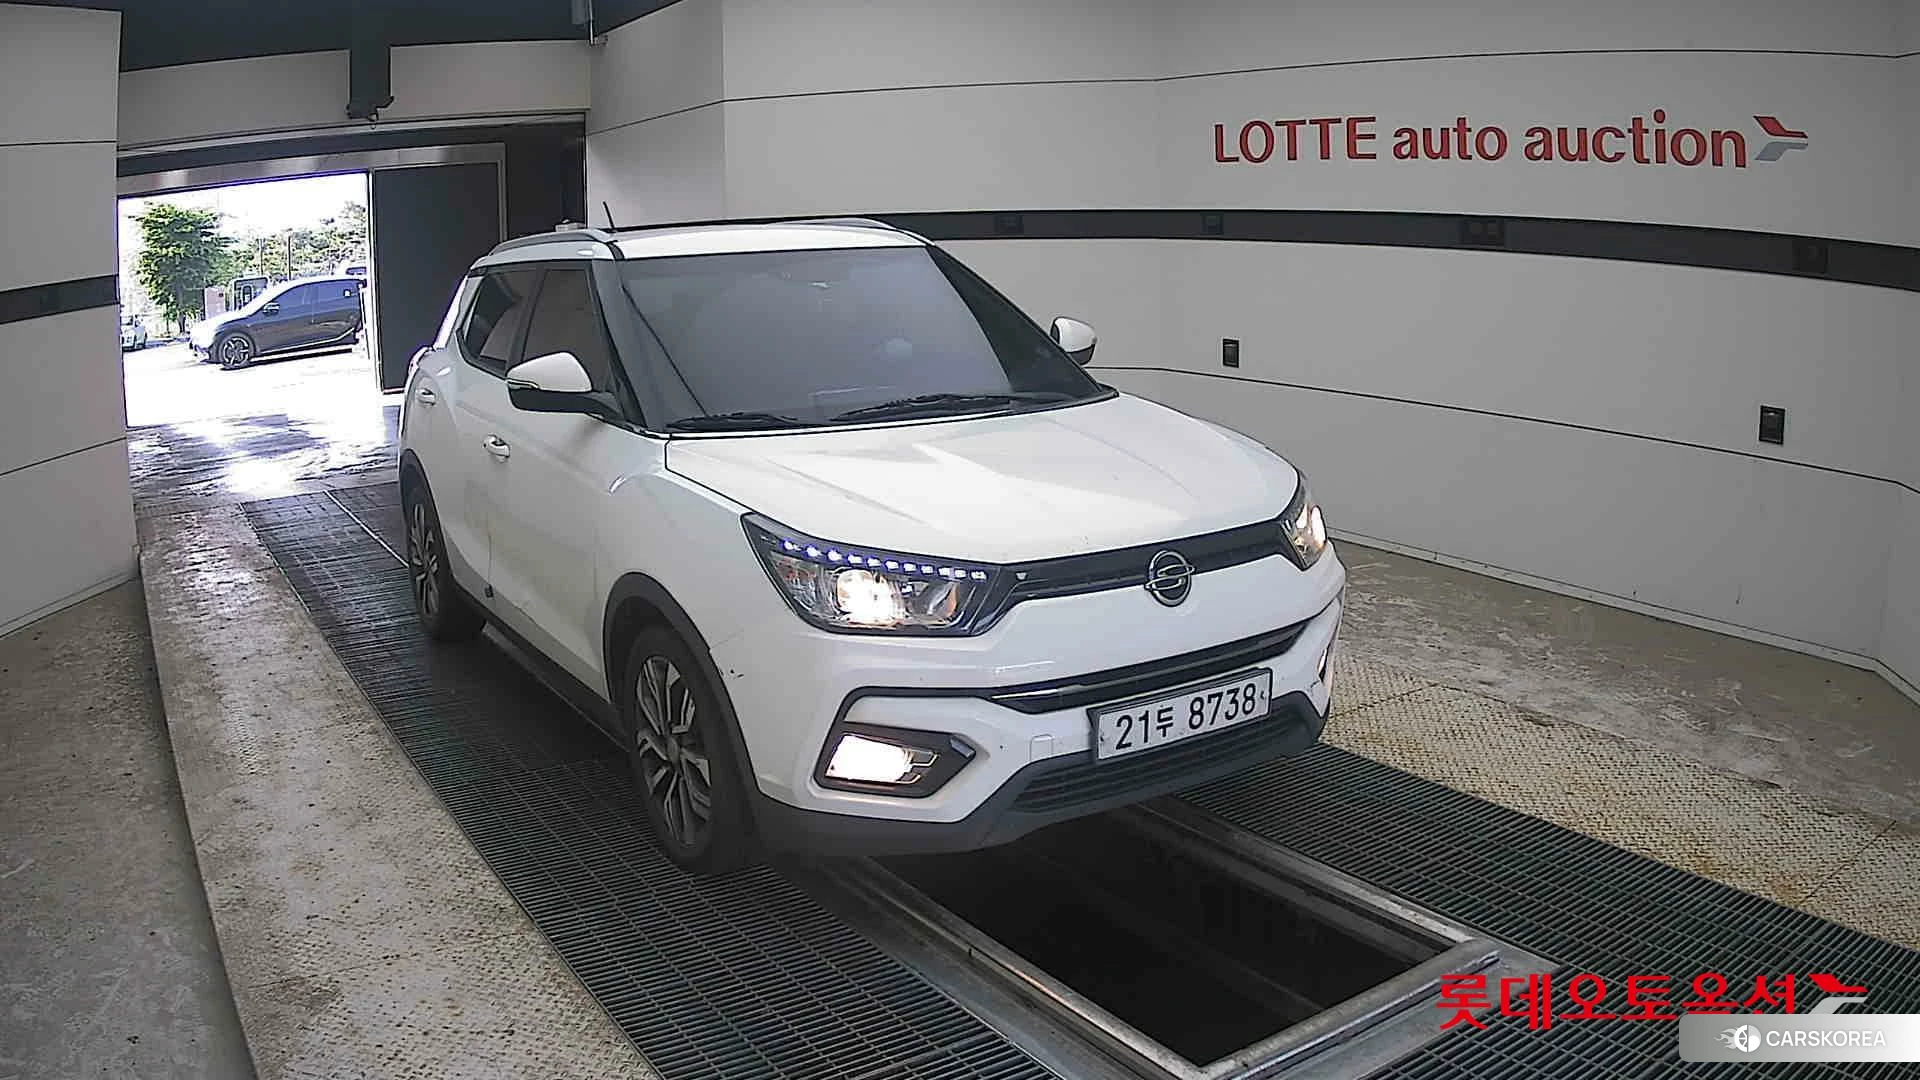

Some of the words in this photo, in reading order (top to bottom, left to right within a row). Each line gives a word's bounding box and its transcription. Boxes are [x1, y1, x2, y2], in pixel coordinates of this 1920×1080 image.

[1213, 115, 1378, 164] LOTTE
[1392, 116, 1509, 161] auto
[1524, 108, 1748, 169] auction
[1114, 706, 1175, 751] 21두
[1187, 682, 1257, 731] 8738
